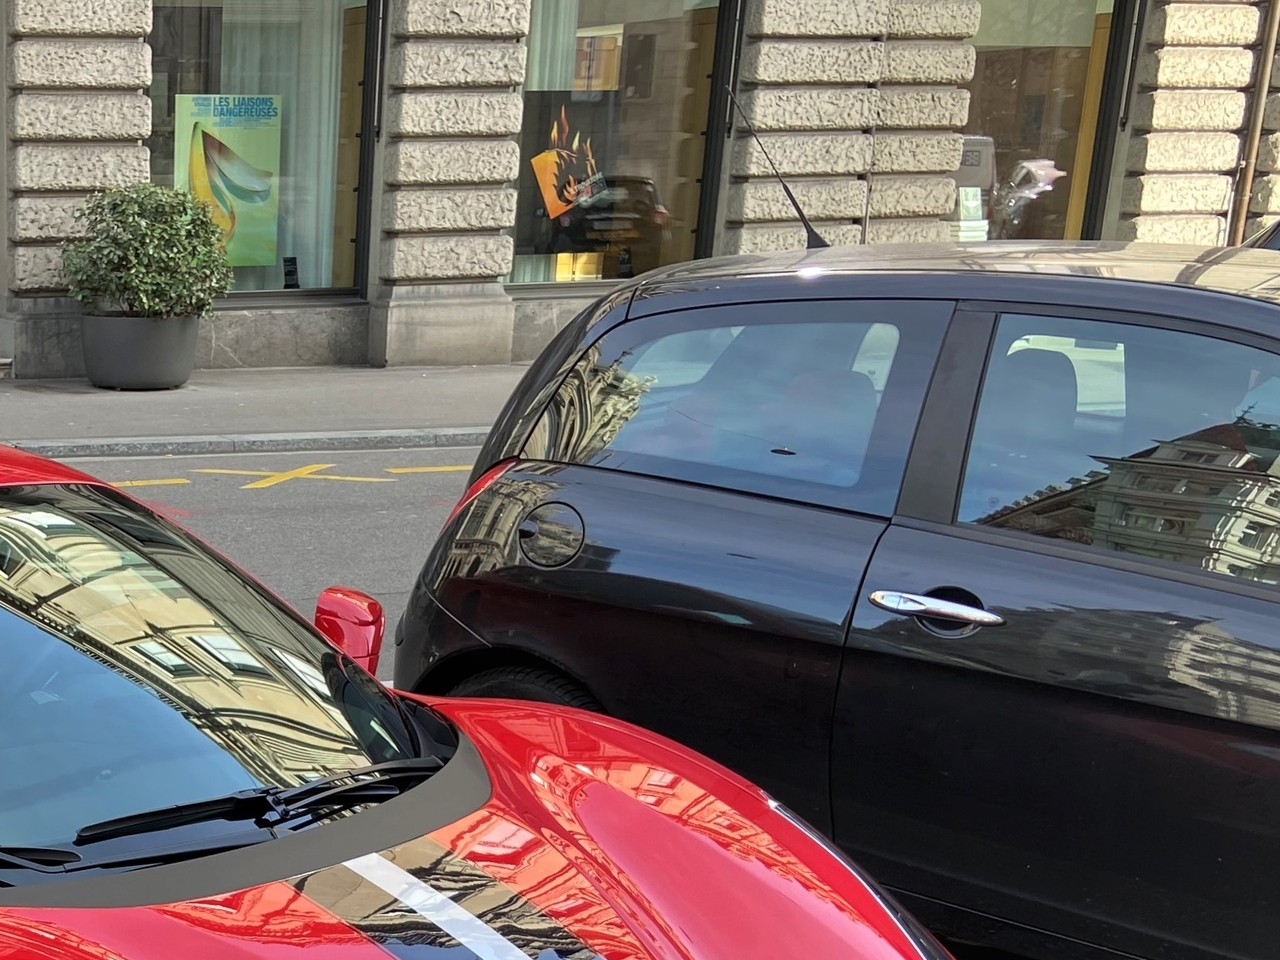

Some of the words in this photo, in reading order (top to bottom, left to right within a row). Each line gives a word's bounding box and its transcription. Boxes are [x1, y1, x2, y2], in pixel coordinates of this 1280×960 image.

[213, 97, 230, 107] LES
[233, 97, 274, 107] LIAISONS
[213, 107, 278, 117] DANGEREUSES
